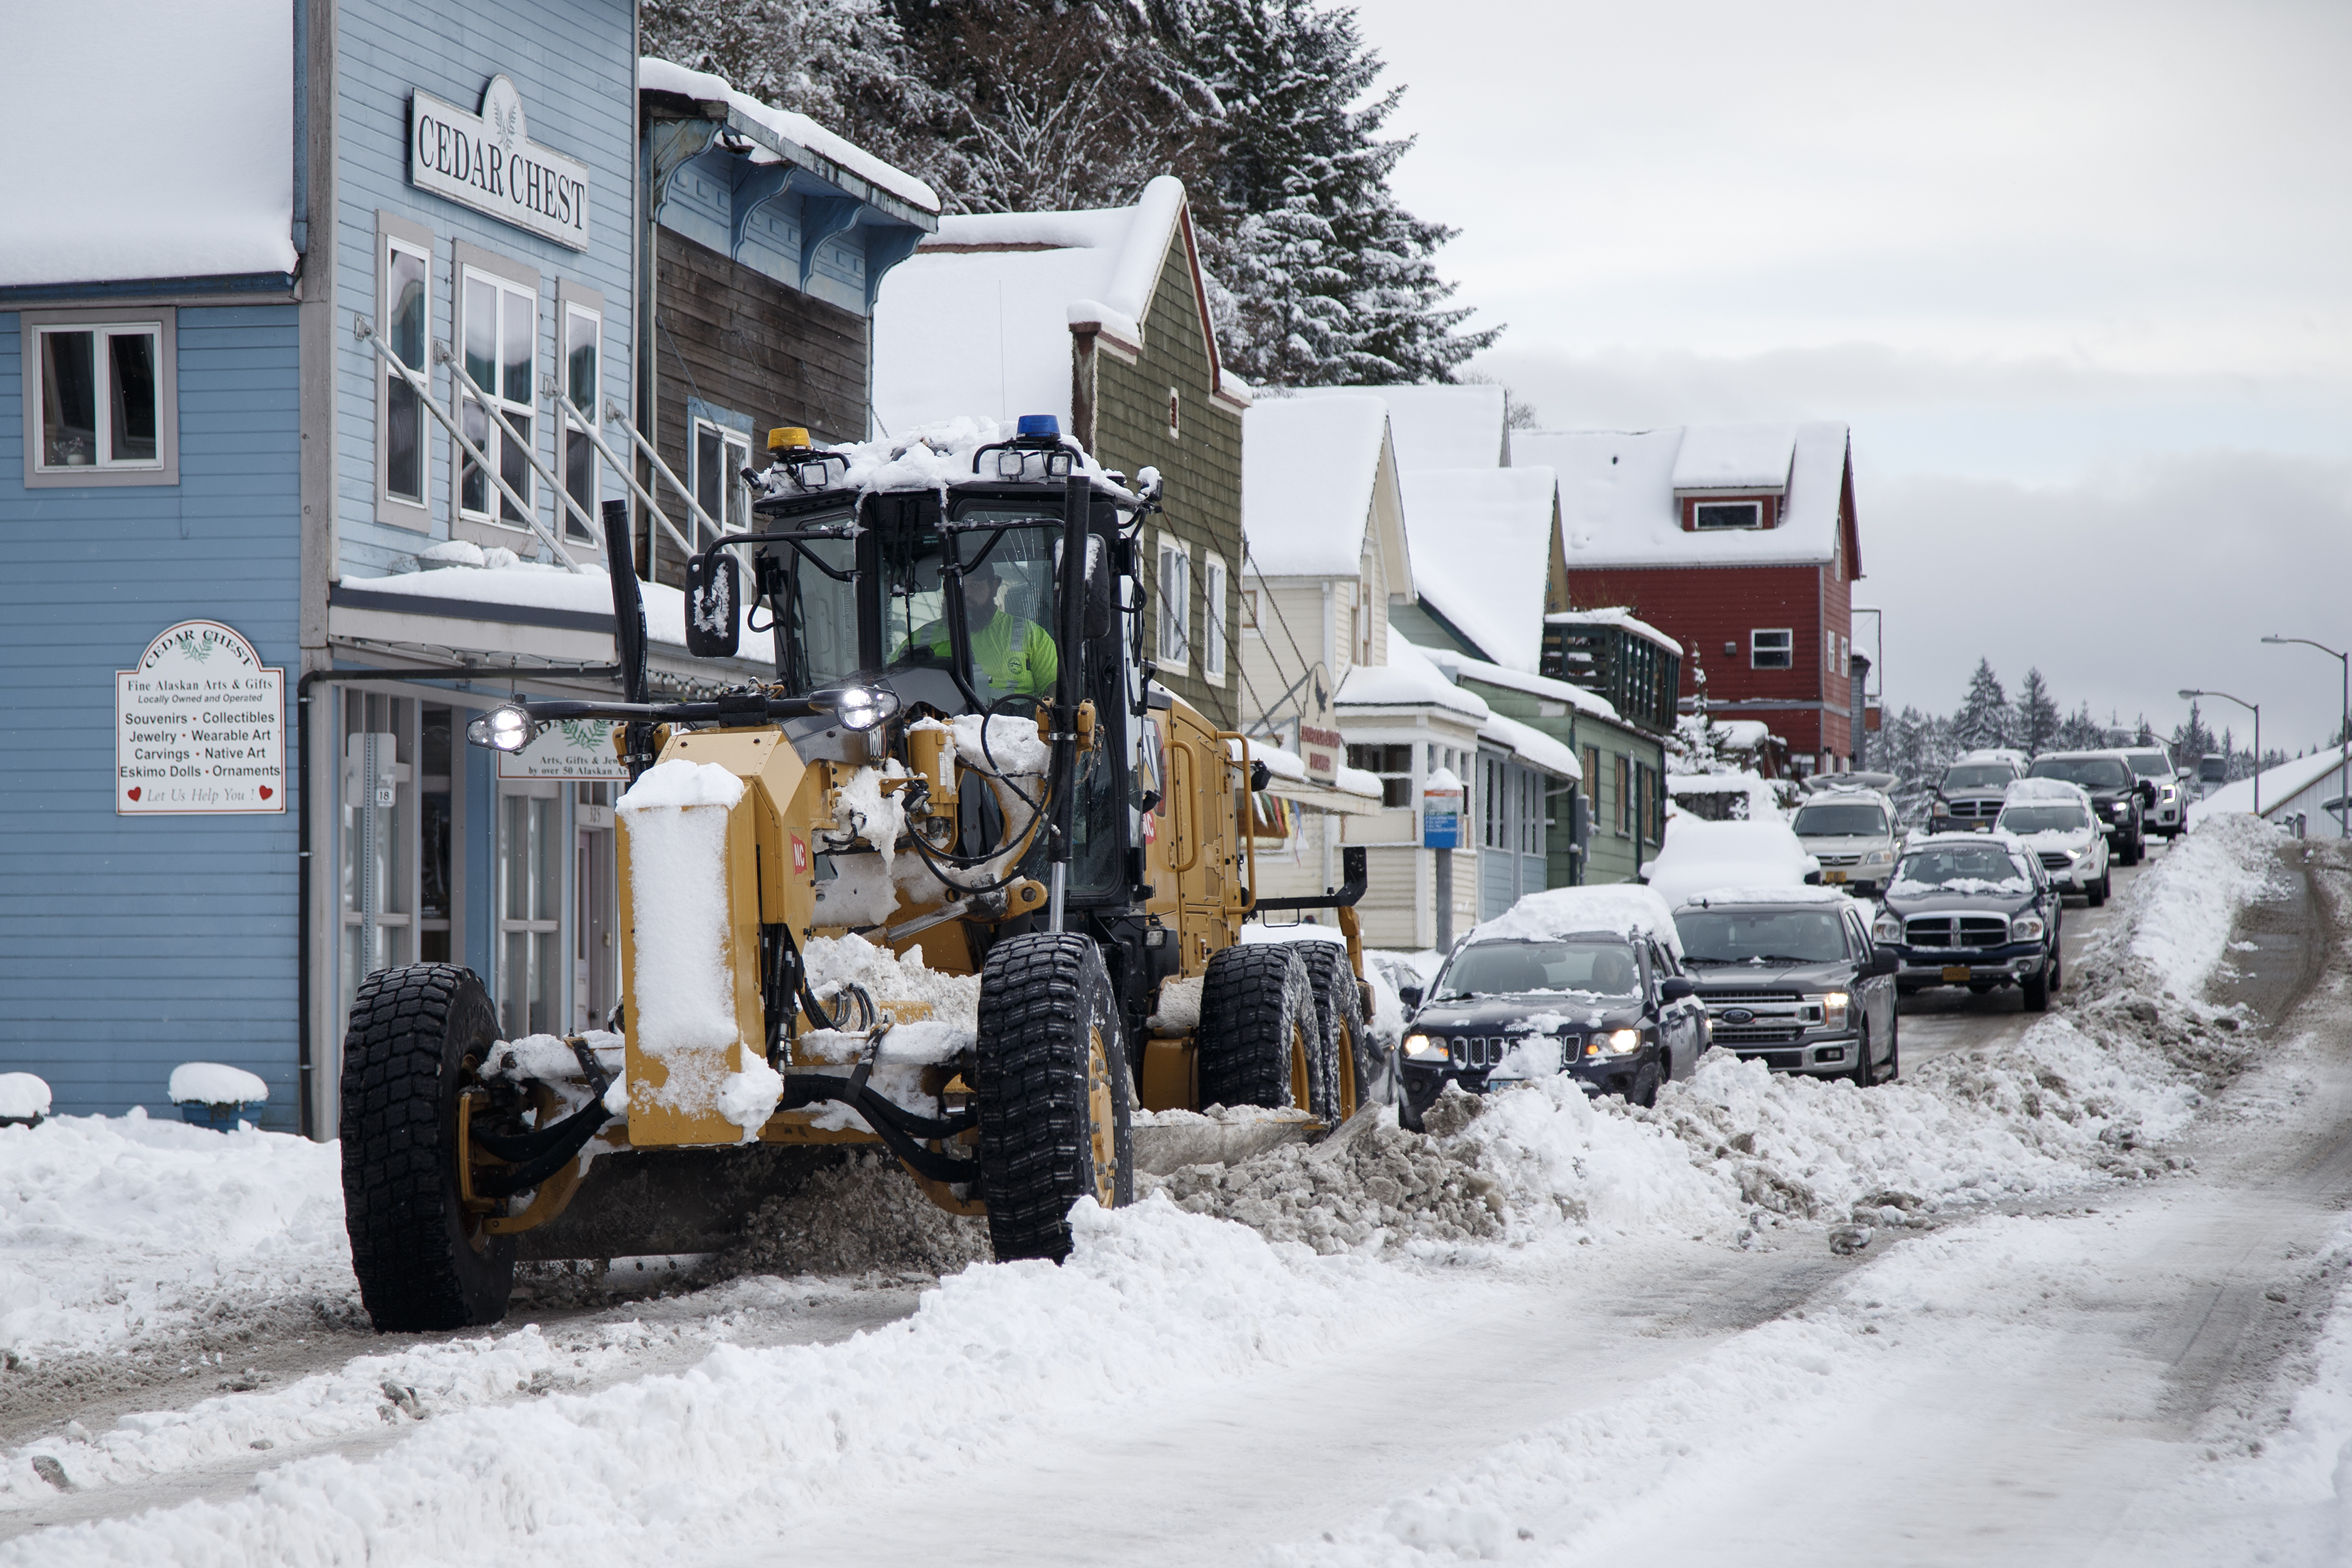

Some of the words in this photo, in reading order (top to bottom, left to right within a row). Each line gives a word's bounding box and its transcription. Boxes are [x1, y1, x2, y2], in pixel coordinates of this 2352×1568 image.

[418, 115, 505, 197] CEDAR
[509, 154, 585, 230] CHEST
[145, 630, 195, 669] CEDAR
[202, 630, 253, 667] CHEST
[128, 680, 151, 691] Fine
[155, 679, 199, 691] Alaskan
[204, 679, 227, 691] Arts
[232, 679, 240, 690] &
[245, 679, 272, 690] Gifts
[138, 695, 170, 706] Locally
[172, 694, 202, 703] Owned
[204, 693, 220, 703] and
[222, 693, 263, 703] Operated
[125, 713, 187, 726] Souvenirs
[202, 711, 275, 724] Collectibles
[129, 731, 177, 745] Jewelry
[191, 729, 249, 742] Wearable
[252, 729, 271, 741] Art
[868, 725, 882, 756] 160
[135, 748, 190, 763] Carvings
[205, 747, 244, 759] Native
[247, 746, 266, 758] Art
[540, 755, 562, 765] Arts,
[565, 755, 589, 765] Gifts
[592, 756, 599, 765] &
[602, 755, 619, 765] Jew
[120, 765, 166, 778] Eskimo
[170, 765, 202, 778] Dolls
[212, 765, 281, 777] Ornaments
[528, 766, 538, 776] by
[562, 766, 574, 775] 50
[577, 766, 613, 775] Alaskan
[148, 788, 165, 803] Let
[171, 788, 186, 802] Us
[191, 788, 219, 805] Help
[224, 788, 245, 802] You
[380, 791, 390, 800] 18
[793, 843, 805, 867] NC
